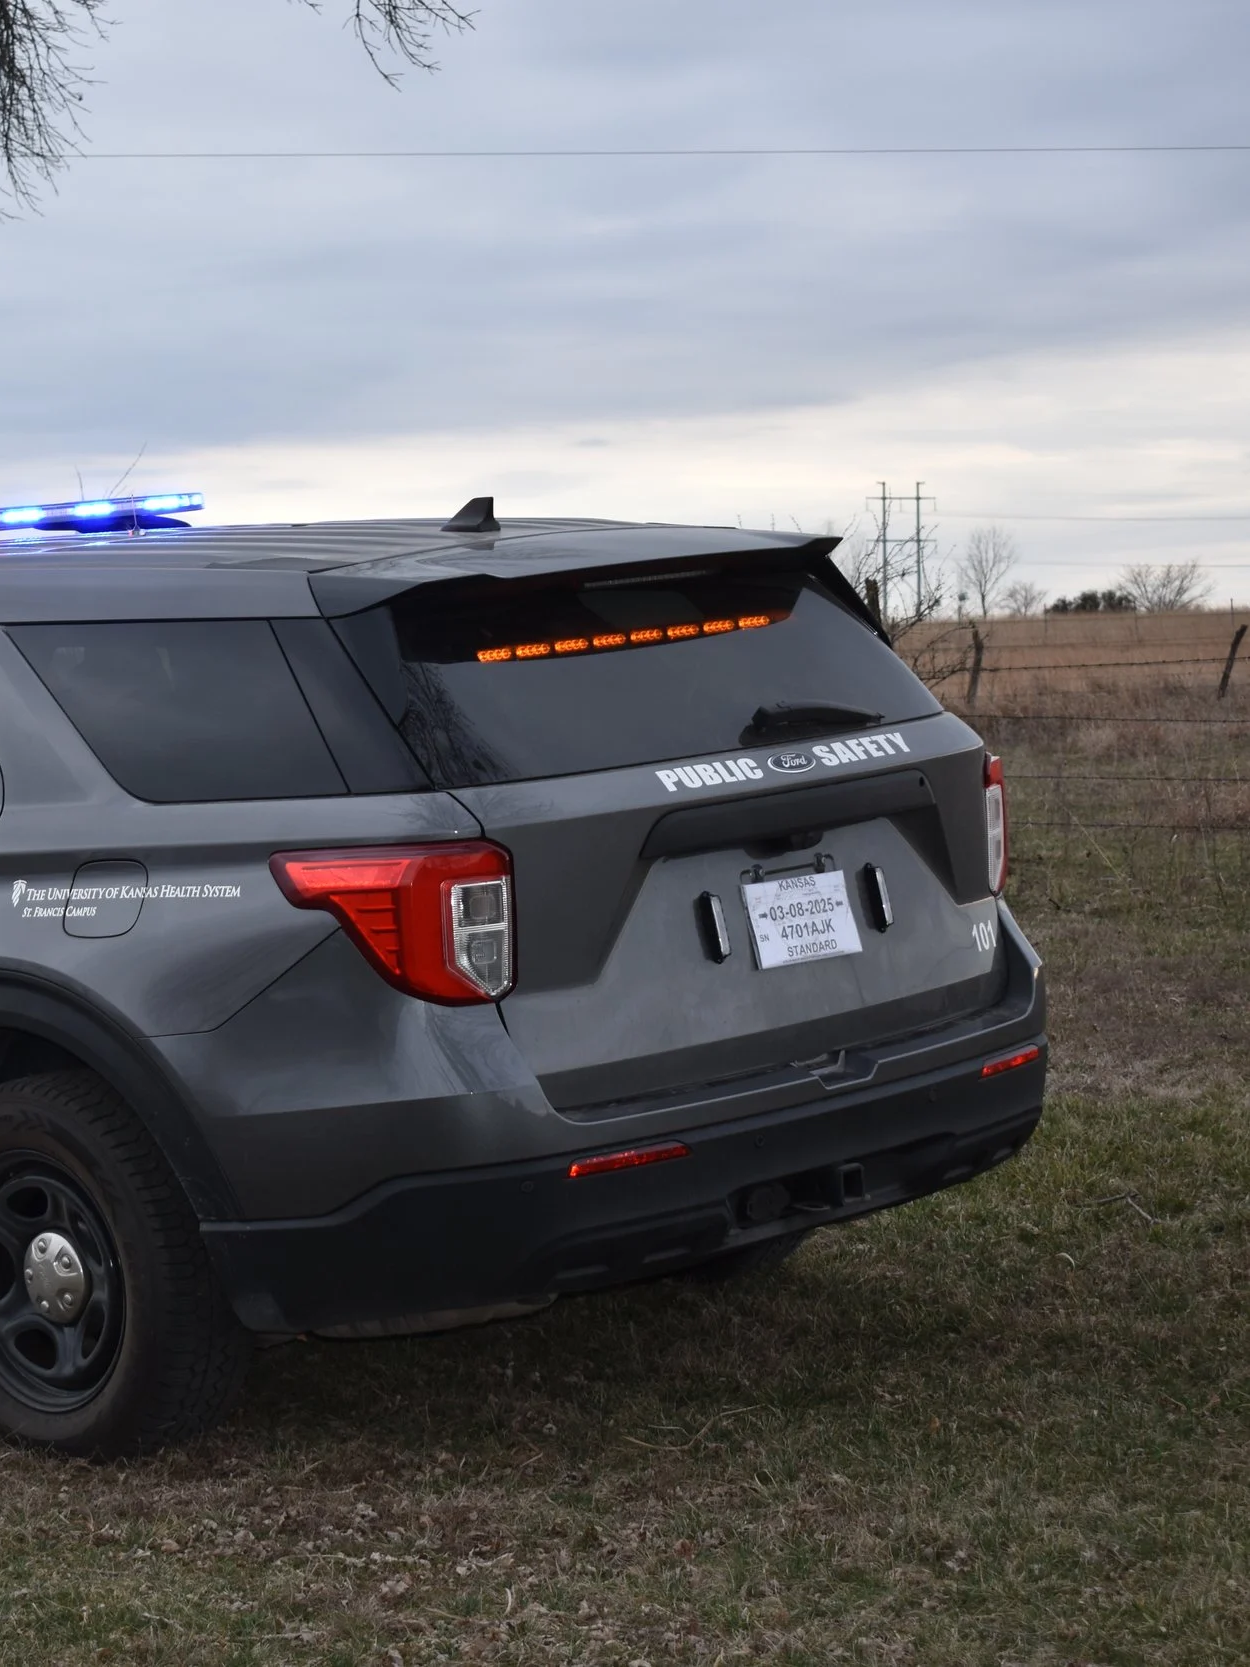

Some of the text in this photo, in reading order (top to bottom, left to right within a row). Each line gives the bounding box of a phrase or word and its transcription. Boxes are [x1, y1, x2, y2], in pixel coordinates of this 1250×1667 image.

[655, 732, 910, 792] PUBLIC SAFETY
[780, 753, 808, 768] Ford
[777, 876, 816, 891] KANSAS
[26, 884, 241, 901] THE UNIVERSITY OF KANSAS HEALTH SYSTEM
[33, 907, 64, 917] FRANCIS
[65, 906, 97, 917] CAMPUS
[769, 898, 835, 921] 03-08-2025
[759, 934, 770, 942] SN
[781, 919, 835, 940] 4701AJK
[972, 919, 997, 952] 101
[787, 939, 838, 957] STANDARD
